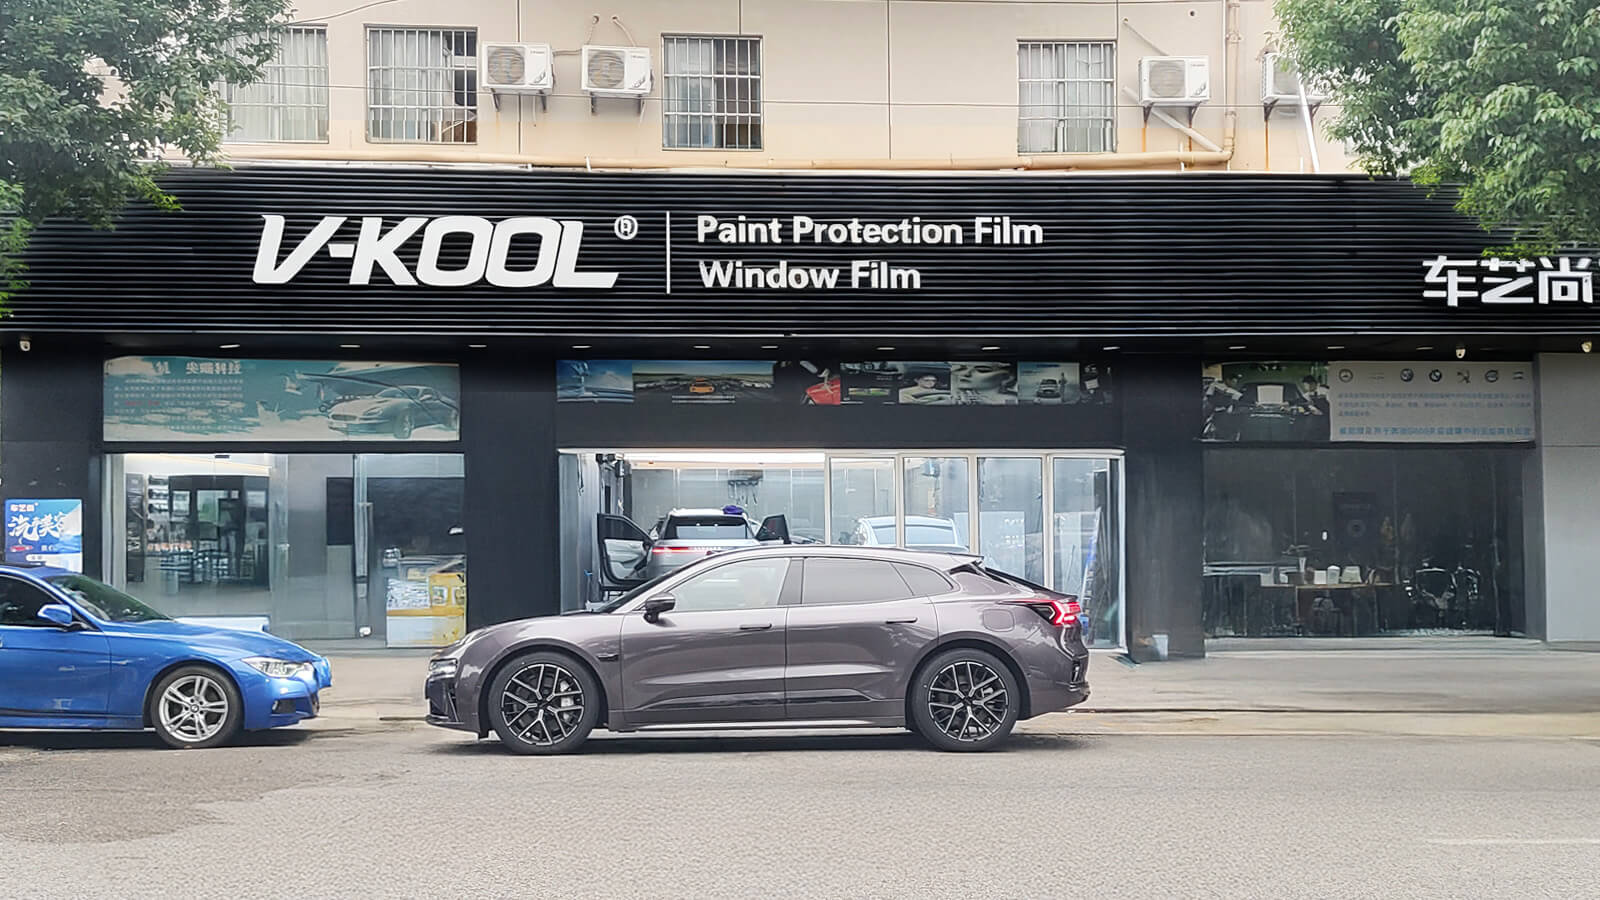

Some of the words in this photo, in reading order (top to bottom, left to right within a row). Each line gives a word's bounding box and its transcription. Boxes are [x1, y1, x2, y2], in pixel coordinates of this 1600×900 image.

[697, 216, 782, 244] Paint
[793, 216, 964, 245] Protection
[974, 216, 1044, 246] Film
[252, 214, 619, 289] V-KOOL
[699, 260, 840, 290] Window
[851, 260, 921, 290] Film
